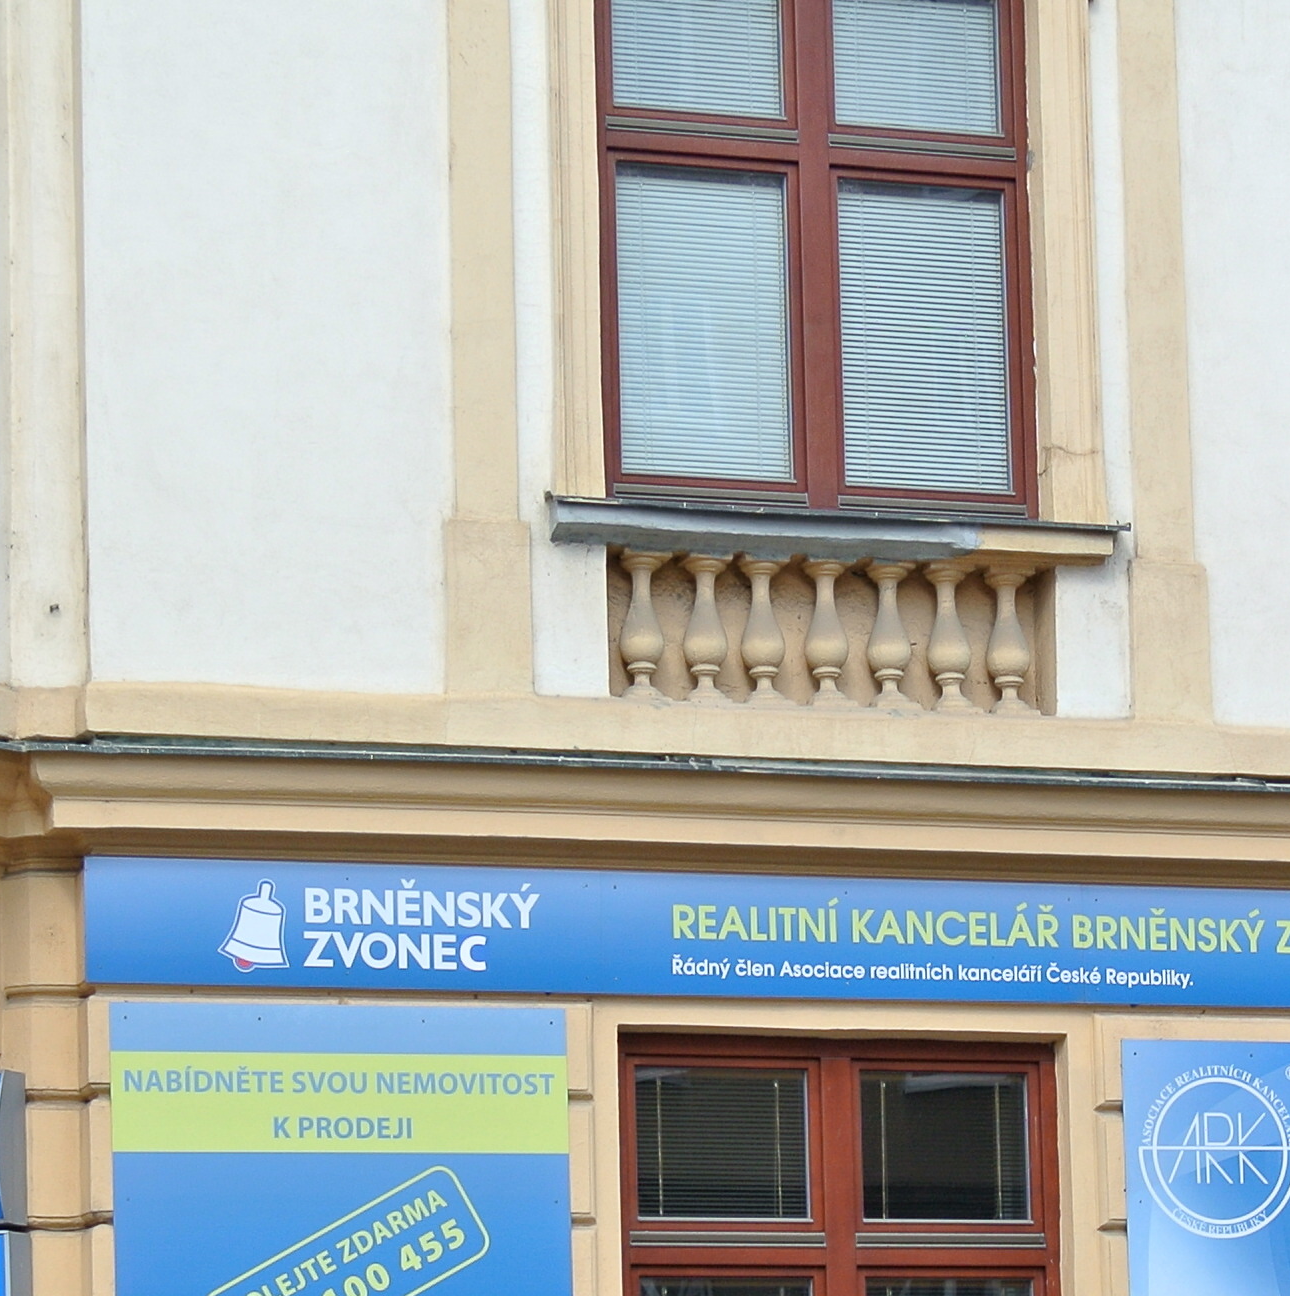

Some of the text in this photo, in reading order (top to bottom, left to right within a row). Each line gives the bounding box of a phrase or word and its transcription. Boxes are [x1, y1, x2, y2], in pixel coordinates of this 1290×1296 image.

[304, 879, 540, 929] BRNĚNSKÝ
[672, 897, 839, 943] REALITNÍ
[851, 901, 1060, 948] KANCELÁŘ
[1072, 907, 1265, 953] BRNĚNSKÝ
[303, 931, 488, 972] ZVONEC
[672, 954, 1194, 990] Řádný člen Asociace realitních kanceláří České Republiky.
[123, 1065, 555, 1097] NABÍDNĚTE SVOU NEMOVITOST
[1141, 1083, 1176, 1145] ASOCIACE
[1174, 1064, 1252, 1087] REALITNÍCH
[272, 1116, 413, 1140] K PRODEJI
[1168, 1111, 1269, 1185] ARK
[335, 1188, 448, 1265] ZDARMA
[398, 1218, 467, 1273] 455
